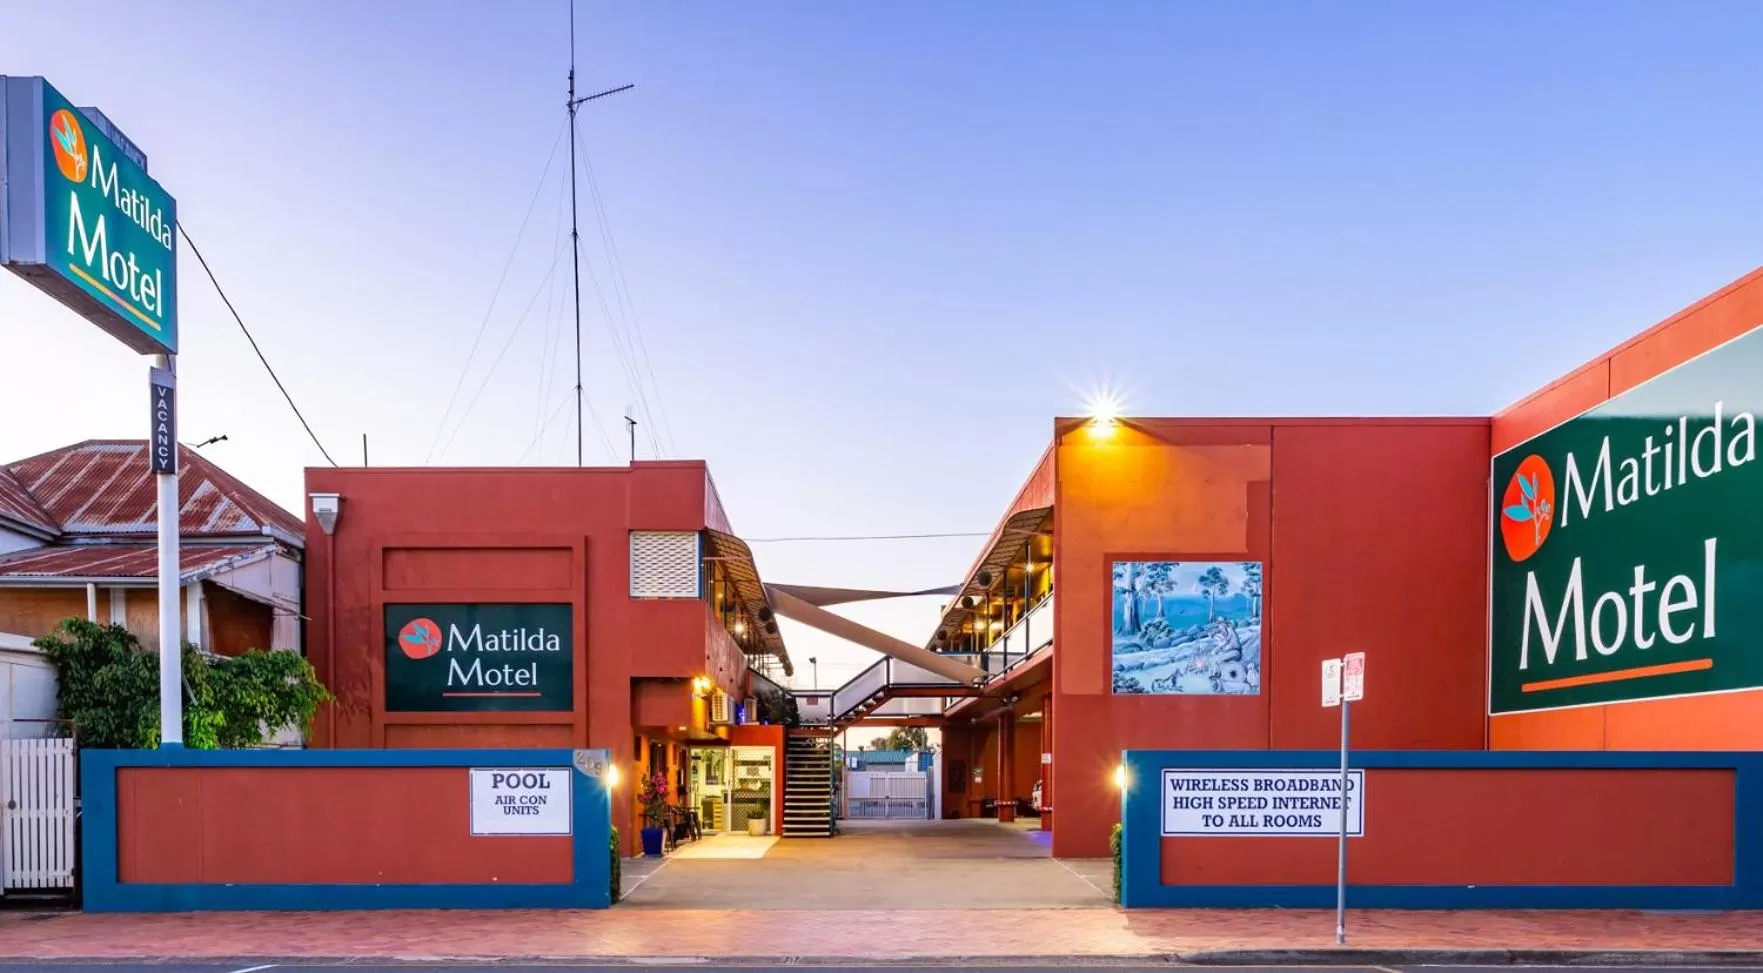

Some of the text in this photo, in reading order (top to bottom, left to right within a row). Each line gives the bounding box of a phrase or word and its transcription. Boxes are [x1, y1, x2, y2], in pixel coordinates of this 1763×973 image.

[91, 144, 171, 250] Matilda
[67, 190, 162, 318] Motel
[157, 386, 168, 469] VACANCY
[1561, 400, 1756, 527] Matilda
[1519, 537, 1717, 670] Motel
[447, 623, 560, 652] Matilda
[447, 657, 537, 686] Motel
[492, 773, 550, 789] POOL
[1170, 778, 1249, 791] WIRELESS
[495, 795, 547, 805] AIR CON
[503, 806, 539, 815] UNITS
[1173, 796, 1213, 809] HIGH
[1218, 796, 1268, 809] SPEED
[1202, 814, 1322, 827] TO ALL ROOMS
